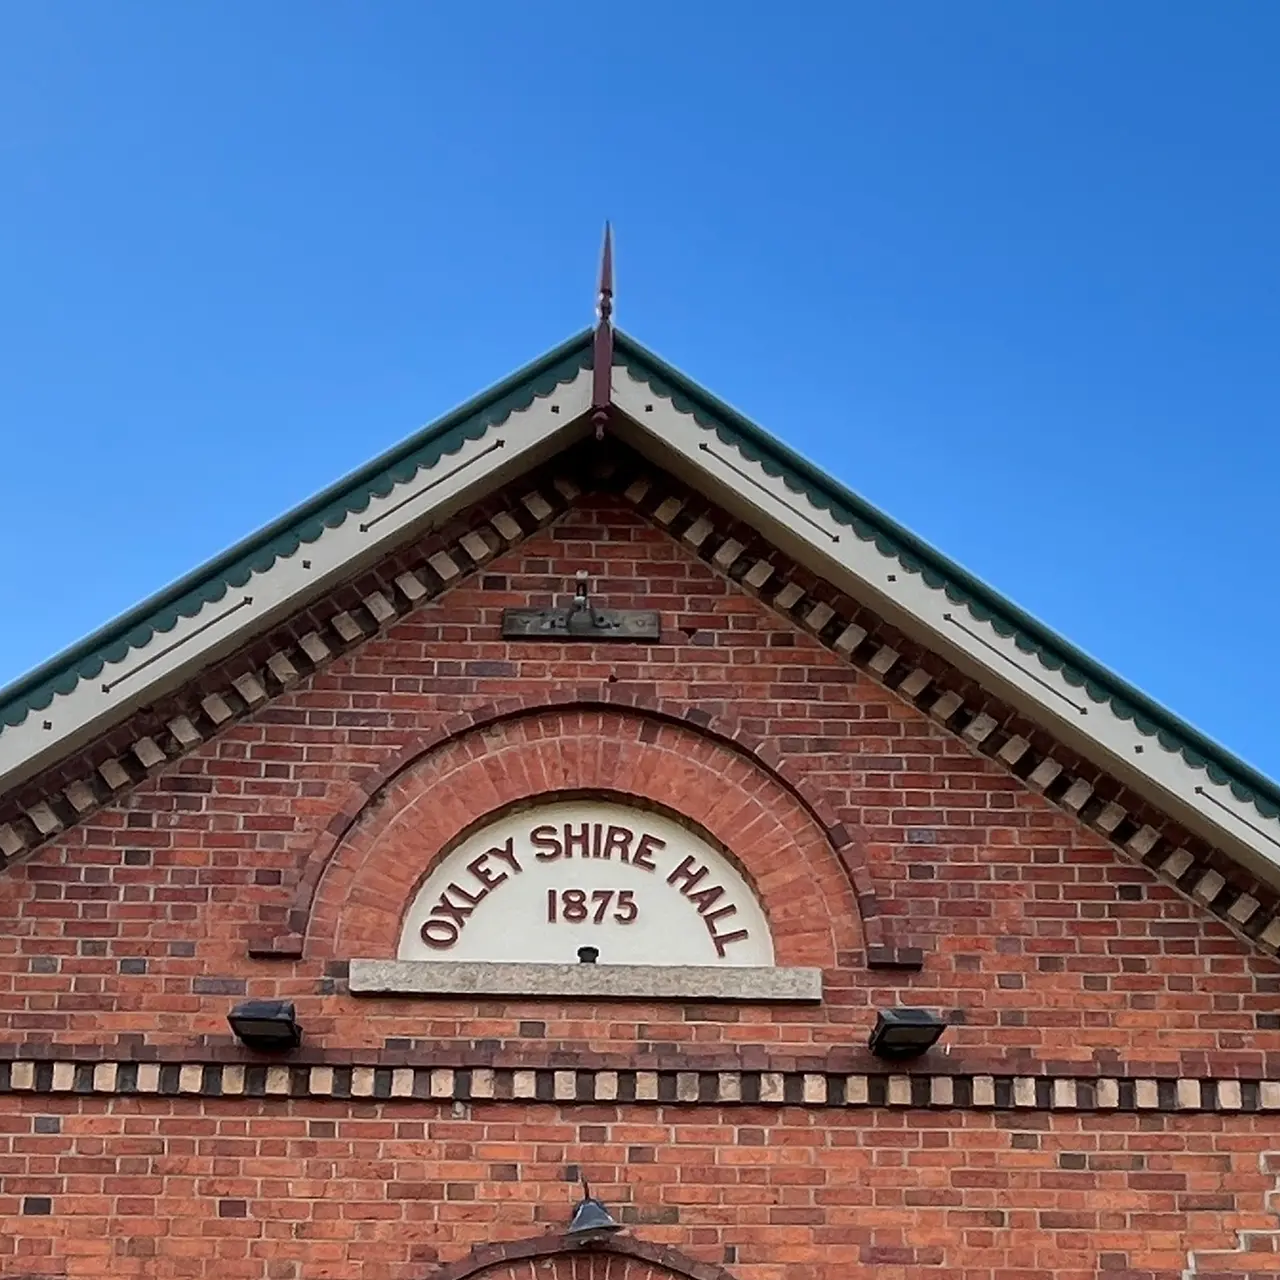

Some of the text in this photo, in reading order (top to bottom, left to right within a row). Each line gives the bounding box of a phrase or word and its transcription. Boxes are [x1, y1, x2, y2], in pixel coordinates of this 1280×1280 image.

[421, 823, 748, 957] OXLEY SHIRE HALL
[547, 890, 638, 924] 1875
